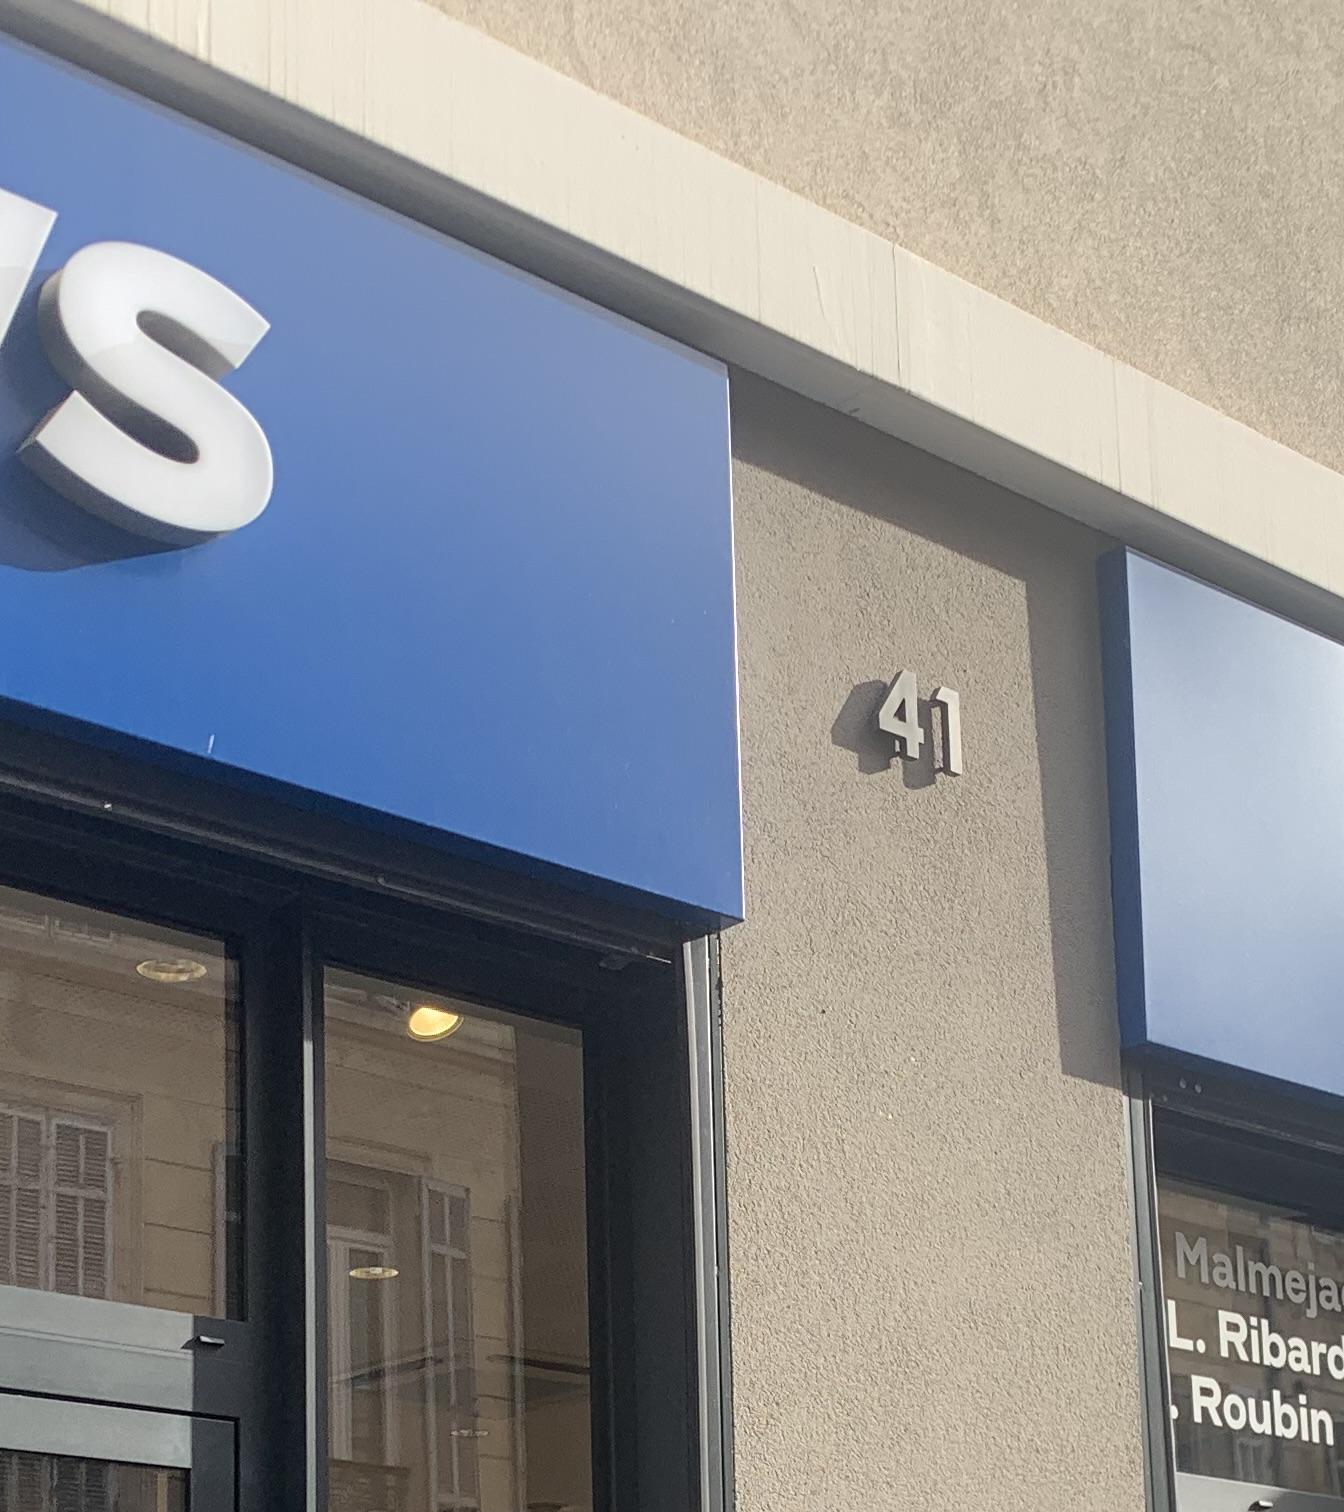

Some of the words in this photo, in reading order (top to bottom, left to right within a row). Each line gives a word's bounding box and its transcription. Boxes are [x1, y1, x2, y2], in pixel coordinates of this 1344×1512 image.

[879, 670, 962, 777] 41
[1167, 1299, 1206, 1353] L.
[1190, 1374, 1335, 1446] Roubin
